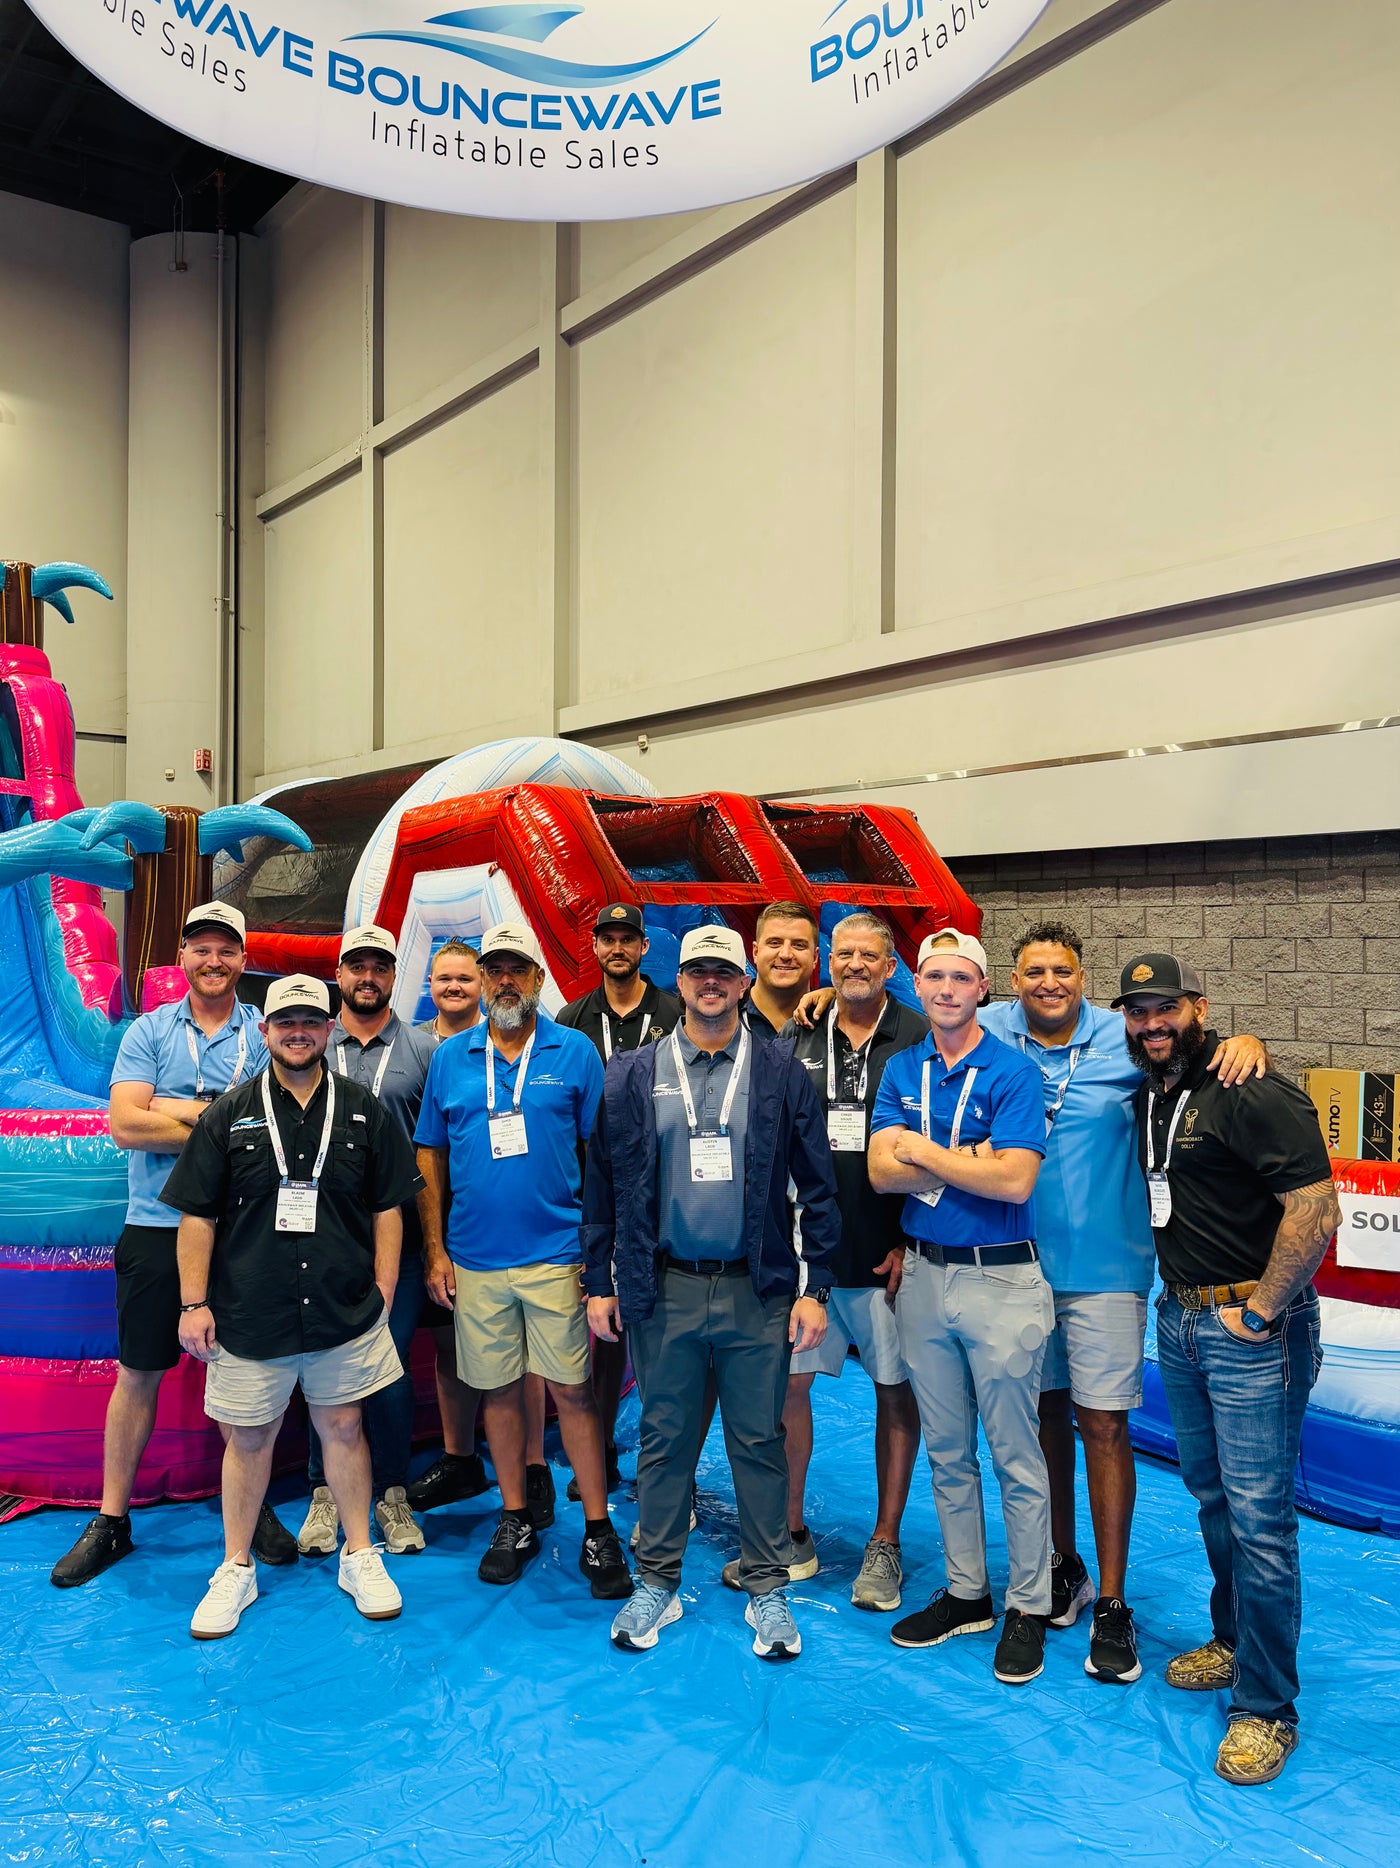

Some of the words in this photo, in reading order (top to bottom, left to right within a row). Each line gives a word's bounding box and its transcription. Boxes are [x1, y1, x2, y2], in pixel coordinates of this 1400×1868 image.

[161, 21, 247, 93] Sales
[328, 50, 722, 131] BOUNCEWAVE
[371, 111, 547, 168] Inflatable
[565, 139, 660, 169] Sales
